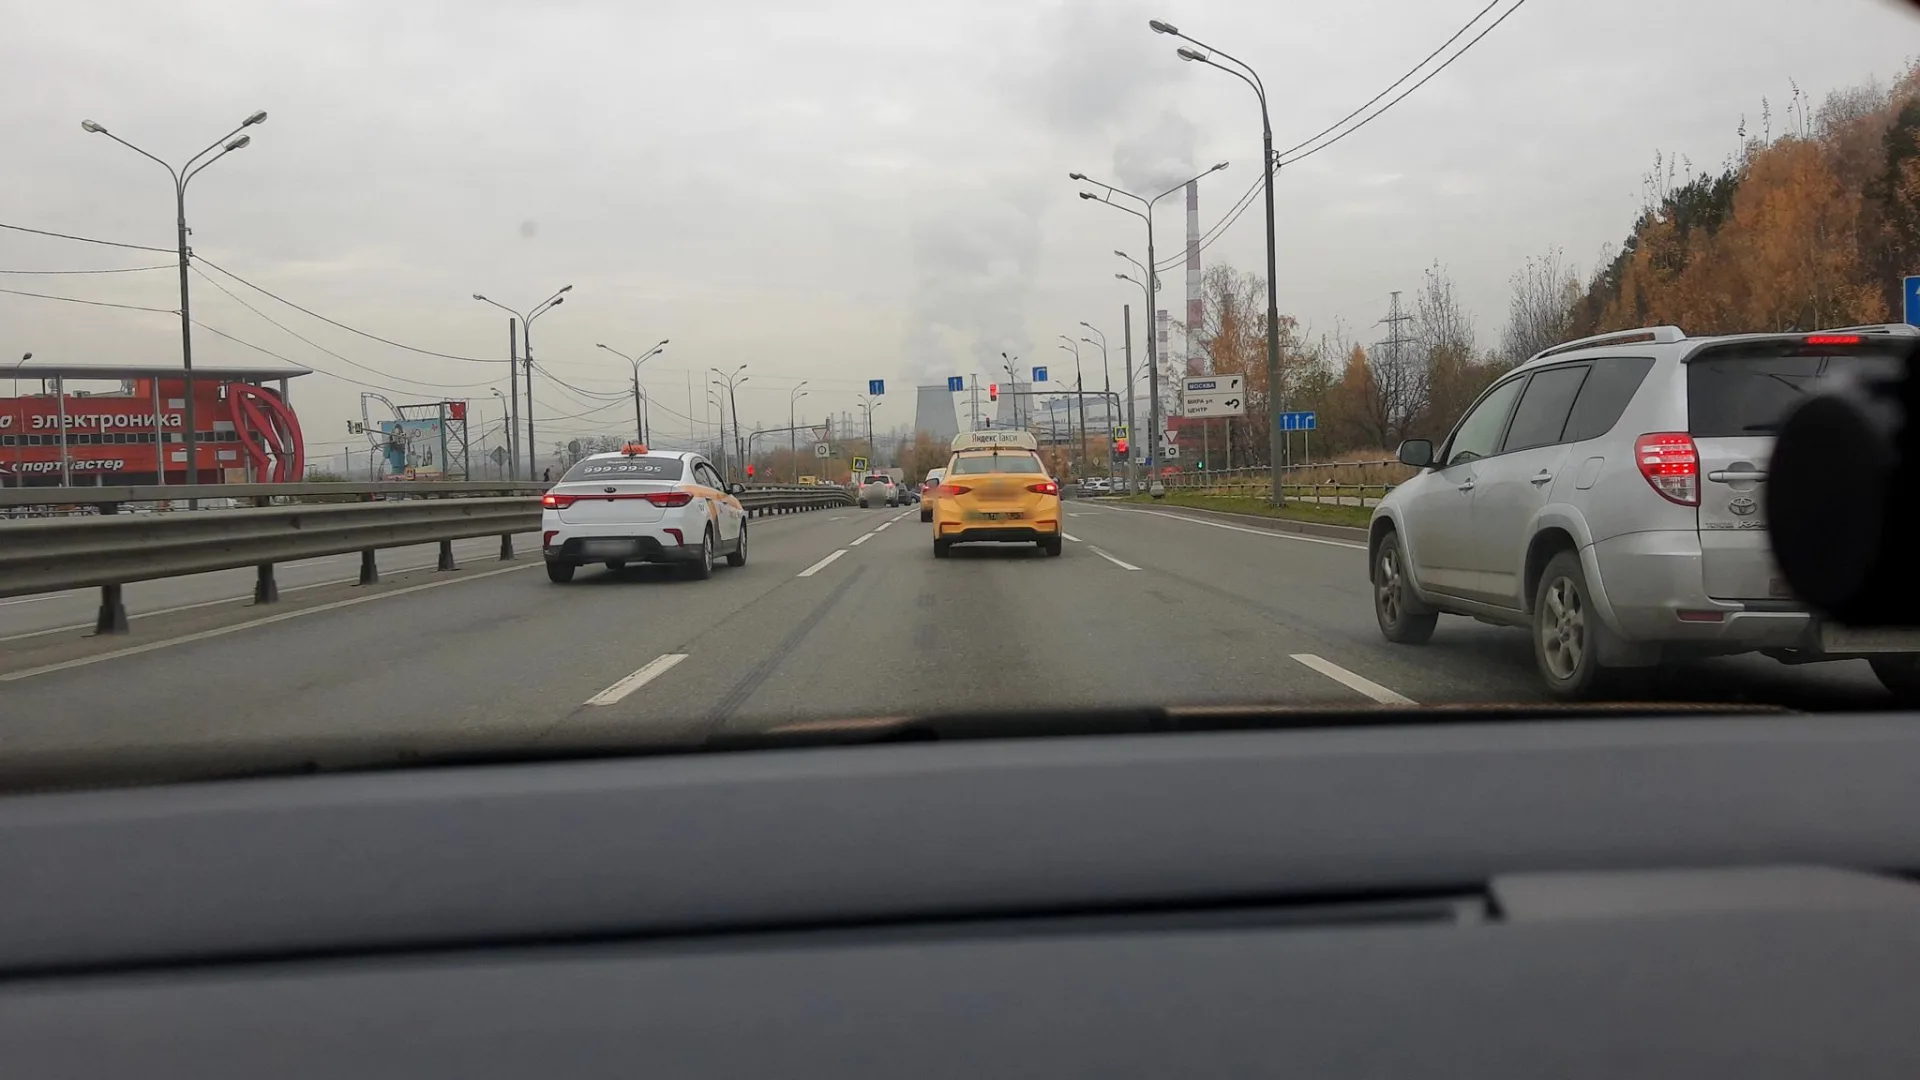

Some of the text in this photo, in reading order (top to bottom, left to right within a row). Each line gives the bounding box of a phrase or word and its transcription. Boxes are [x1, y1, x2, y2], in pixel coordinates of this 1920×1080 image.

[31, 413, 182, 433] электроника
[971, 433, 1018, 443] Яндекс Такси
[11, 459, 124, 474] спортастер
